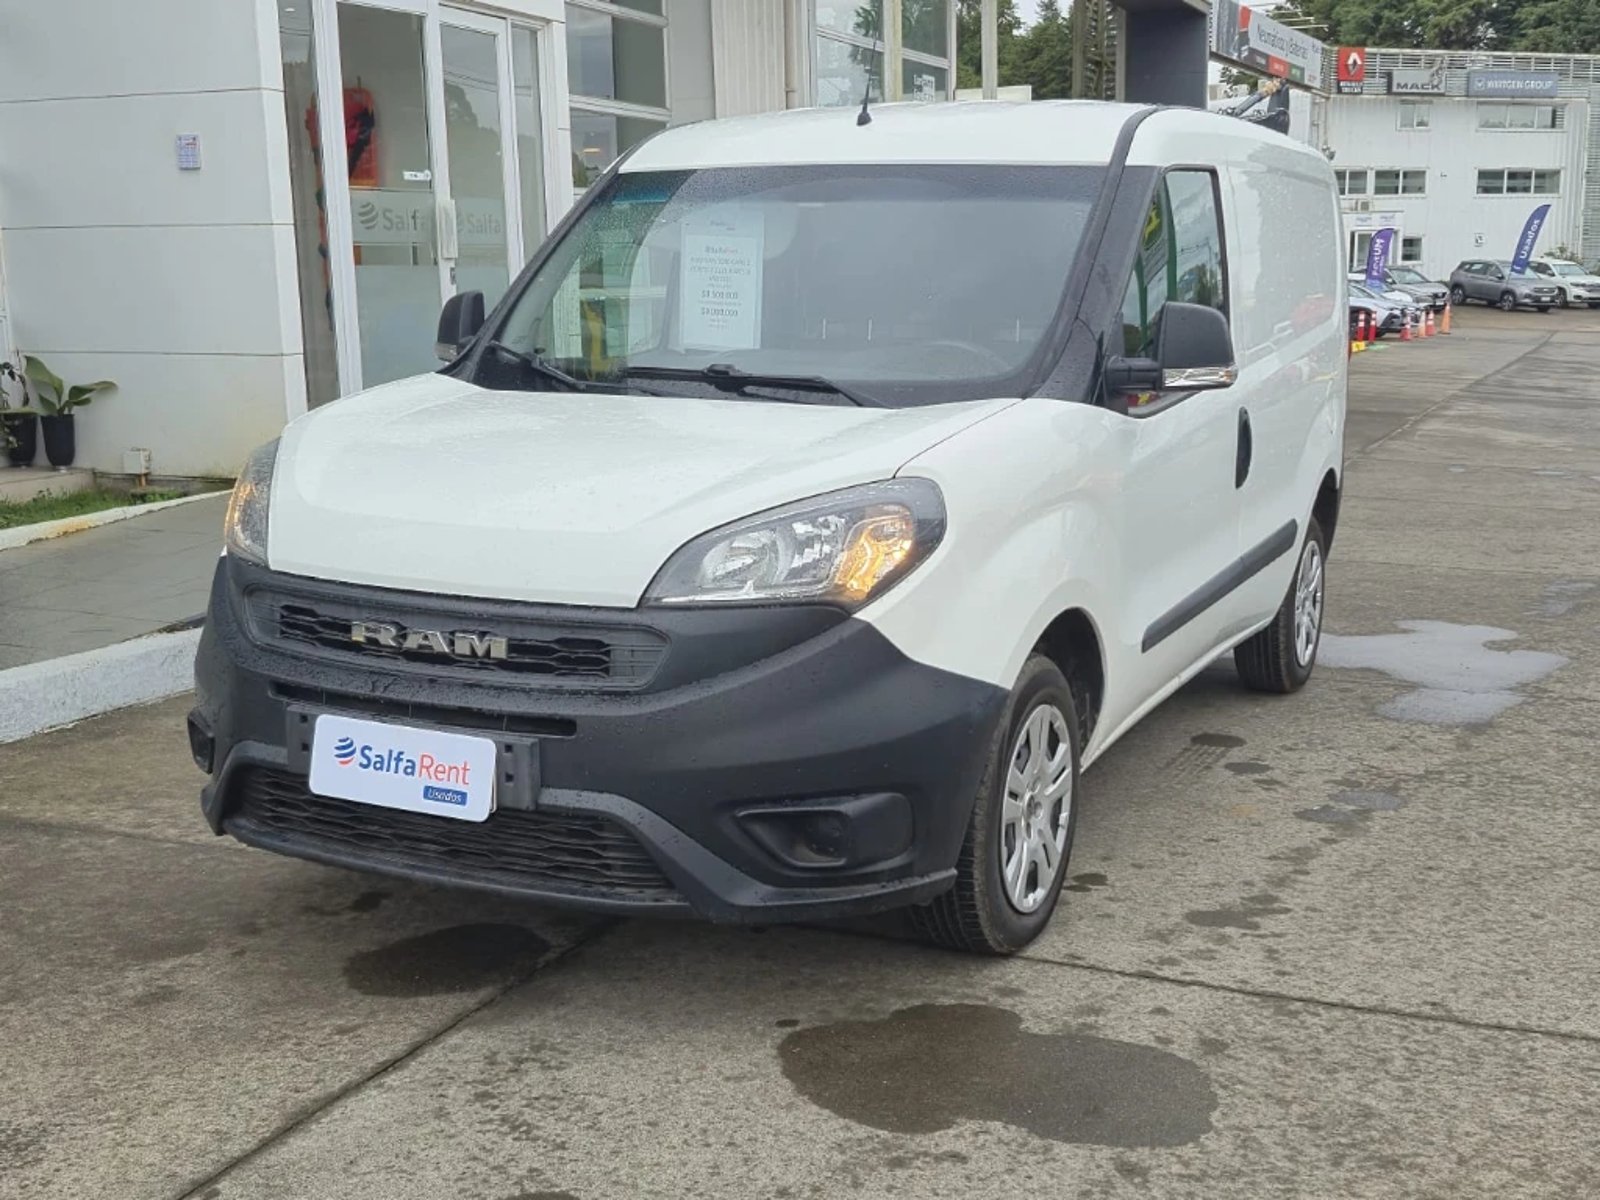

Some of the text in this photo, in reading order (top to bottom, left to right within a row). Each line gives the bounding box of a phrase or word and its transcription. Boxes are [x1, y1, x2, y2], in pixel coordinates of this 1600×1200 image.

[1395, 82, 1442, 91] MACK
[1524, 80, 1554, 90] GROUP
[381, 207, 430, 232] Salfa
[467, 213, 502, 235] Salfa
[1519, 219, 1541, 259] Usados
[350, 620, 508, 659] RAM
[358, 744, 471, 786] SalfaRent
[427, 788, 462, 804] Usados
